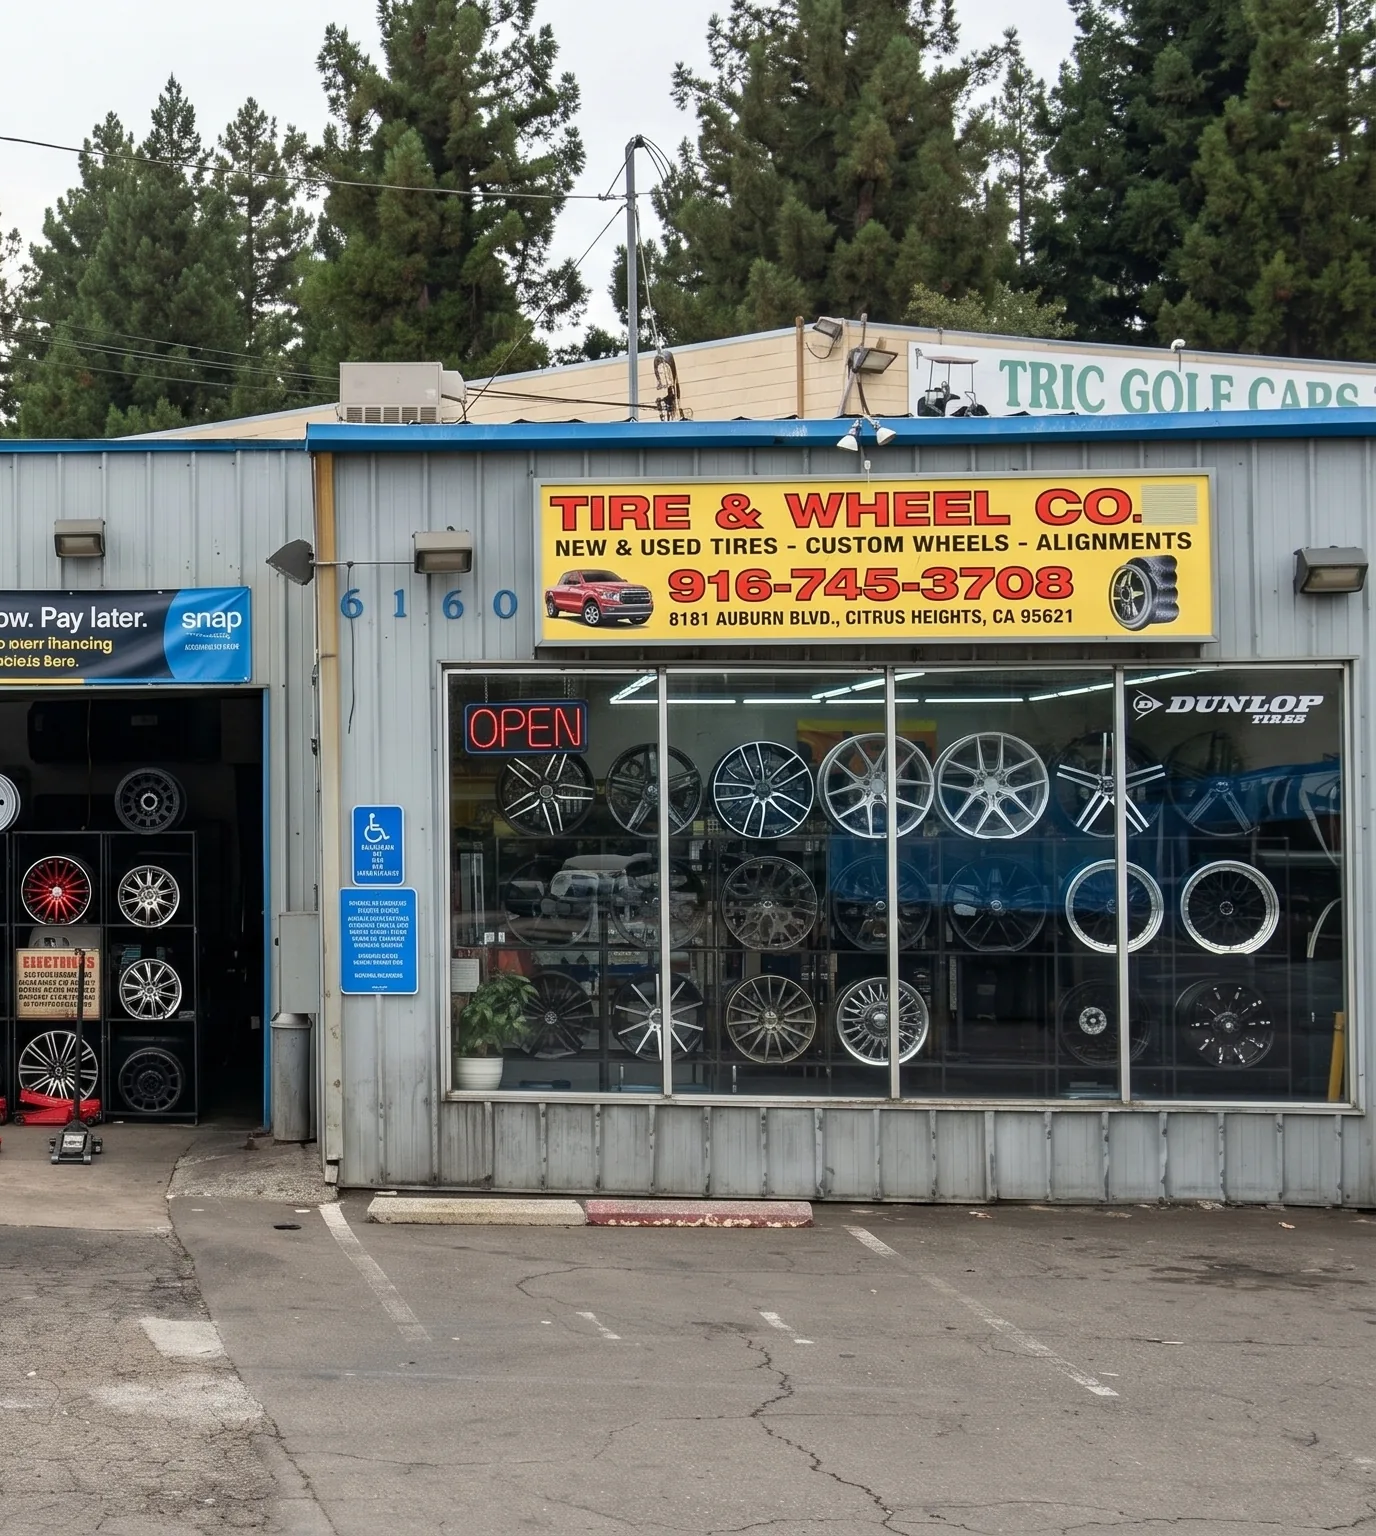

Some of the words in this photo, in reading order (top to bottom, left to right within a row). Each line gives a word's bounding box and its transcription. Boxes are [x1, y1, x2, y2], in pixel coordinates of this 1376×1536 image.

[999, 359, 1106, 414] TRIC
[1121, 367, 1234, 413] GOLF
[549, 494, 691, 532] TIRE
[715, 492, 765, 531] &
[784, 489, 1011, 530] WHEEL
[1035, 487, 1143, 527] CO.
[555, 539, 608, 557] NEW
[615, 539, 633, 557] &
[640, 538, 702, 557] USED
[710, 537, 778, 556] TIRES
[806, 536, 904, 555] CUSTOM
[913, 534, 1010, 553] WHEELS
[1035, 532, 1193, 552] ALIGNMENTS
[667, 565, 1075, 604] 916-745-3708
[40, 606, 84, 634] Pay
[90, 605, 148, 629] later.
[181, 610, 243, 634] snap
[669, 612, 709, 626] 8181
[716, 611, 784, 626] AUBURN
[790, 611, 840, 628] BLVD.,
[845, 610, 906, 625] CITRUS
[911, 609, 988, 627] HEIGHTS,
[992, 609, 1016, 624] CA
[1020, 608, 1074, 624] 95621
[1165, 695, 1324, 713] DUNLOP
[470, 706, 582, 748] OPEN
[1251, 713, 1307, 724] TIRES
